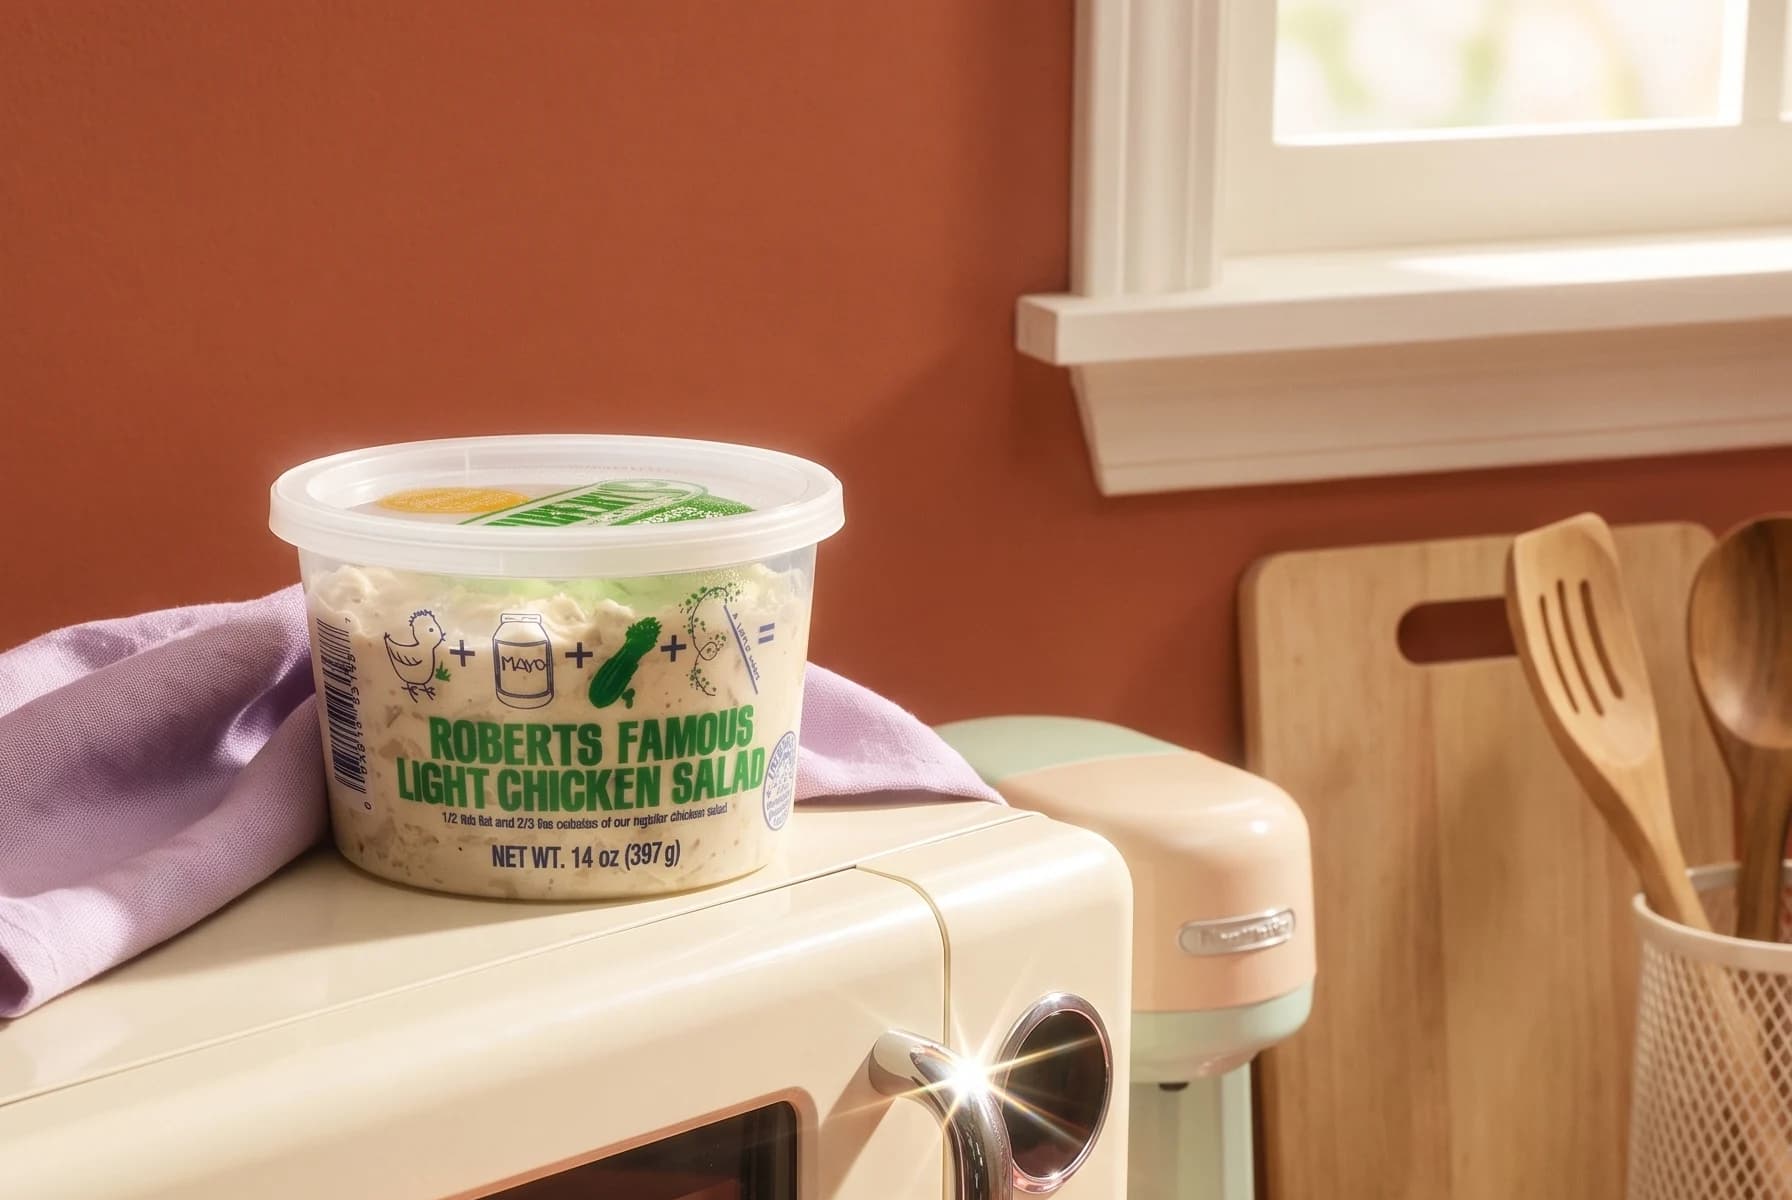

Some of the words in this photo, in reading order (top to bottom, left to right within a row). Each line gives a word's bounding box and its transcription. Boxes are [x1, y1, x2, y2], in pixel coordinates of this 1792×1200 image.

[501, 655, 547, 674] MAYO
[429, 716, 602, 767] ROBERTS
[617, 704, 754, 765] FAMOUS
[396, 757, 490, 809] LIGHT
[496, 764, 661, 812] CHICKEN
[672, 746, 765, 803] SALAD
[442, 812, 458, 825] 1/2
[517, 818, 535, 829] 2/3
[601, 817, 611, 828] of
[614, 818, 631, 828] our
[492, 845, 527, 868] NET
[531, 845, 565, 869] WT.
[572, 846, 593, 868] 14
[600, 850, 619, 868] oz
[624, 842, 660, 871] (397
[664, 839, 682, 867] g)
